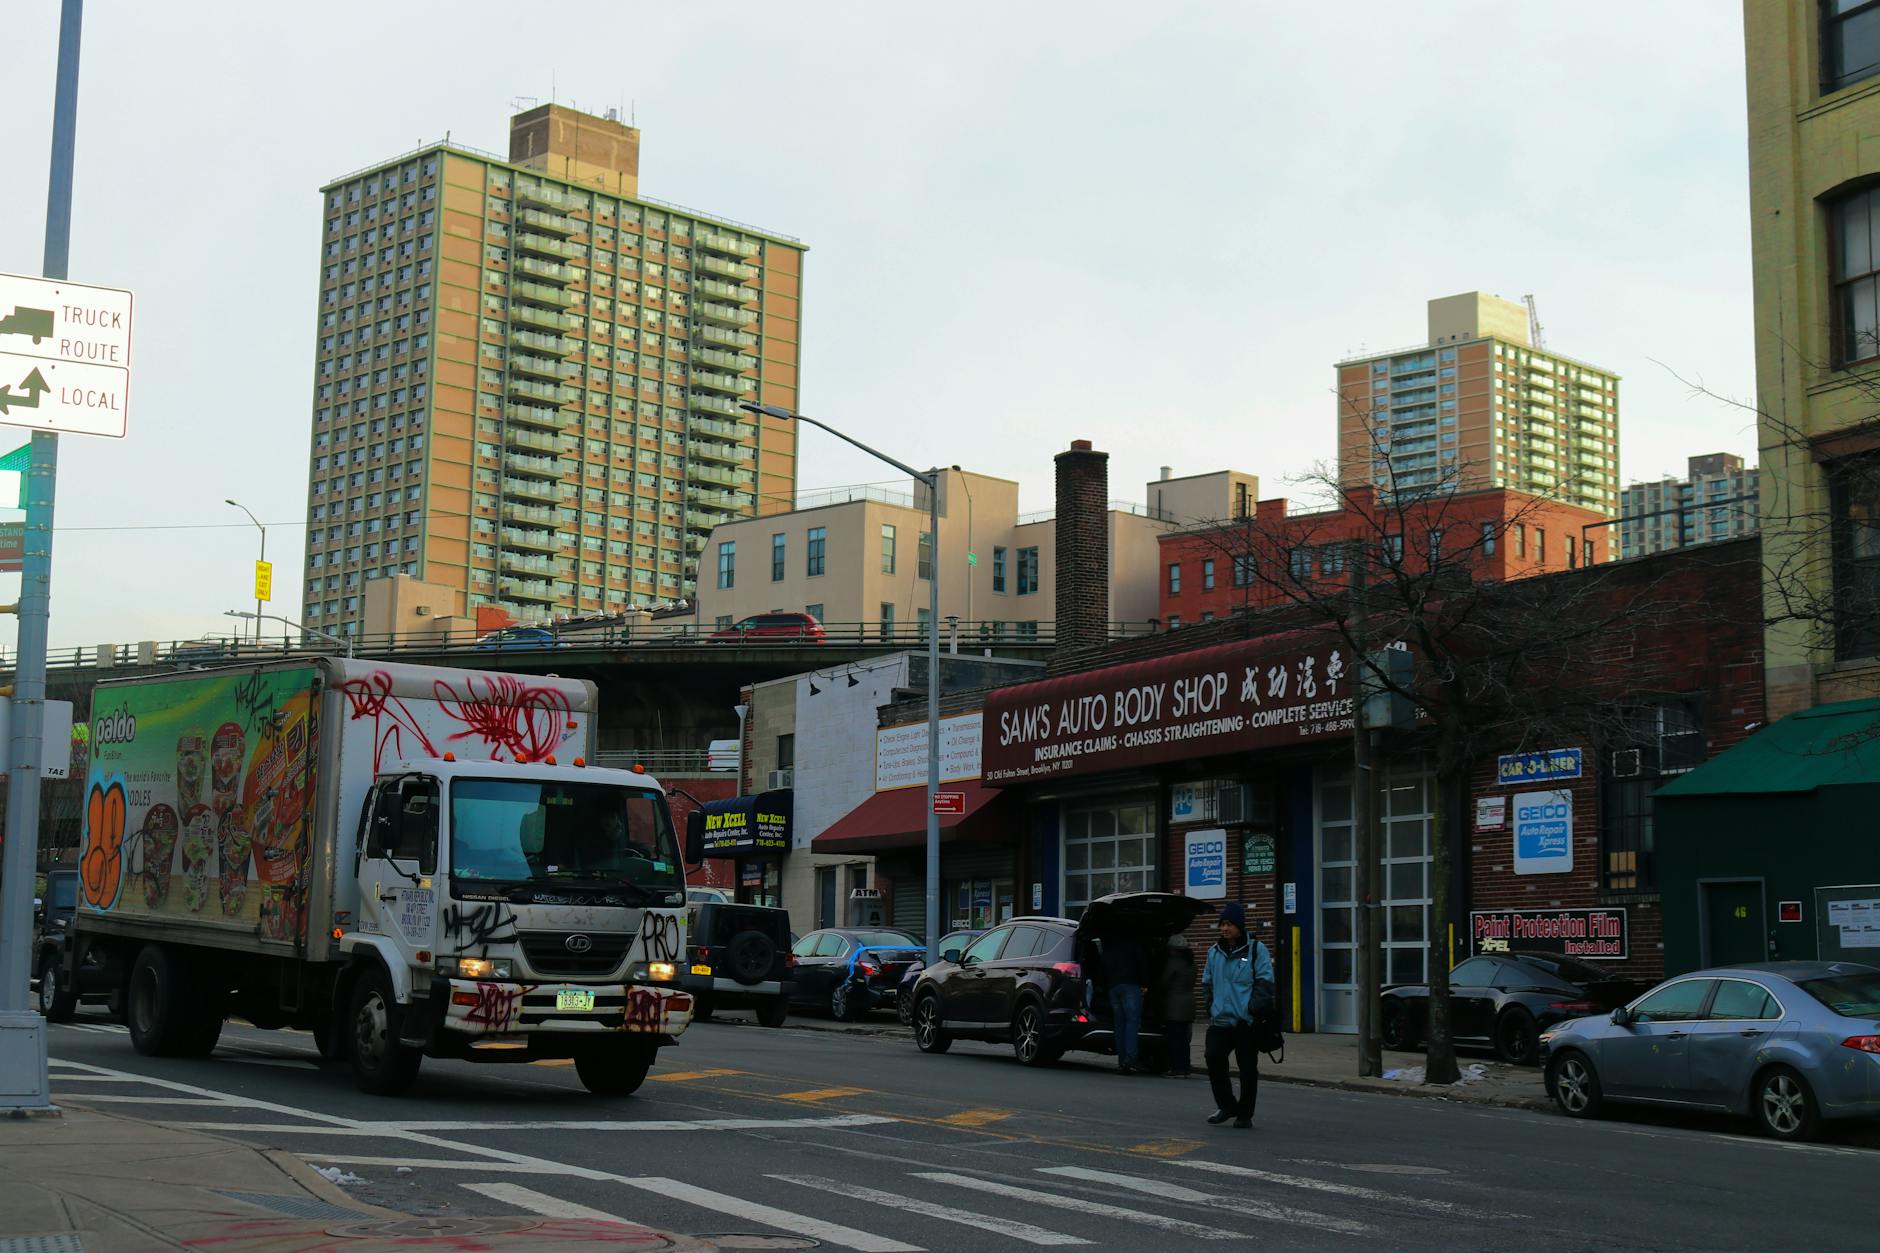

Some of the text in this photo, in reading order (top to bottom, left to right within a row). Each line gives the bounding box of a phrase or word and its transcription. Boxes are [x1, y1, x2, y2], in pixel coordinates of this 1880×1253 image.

[63, 305, 121, 329] TRUCK
[60, 339, 119, 362] ROUTE
[61, 387, 120, 411] LOCAL
[1000, 671, 1229, 747] SAM'S AUTO BODY SHOP
[95, 704, 136, 758] paldo
[1034, 697, 1354, 762] INSURANCE CLAIMS CHASSIS STRAIGHTENING COMPLETE SERVICE
[986, 771, 993, 781] 50
[994, 770, 1003, 780] Old
[128, 790, 152, 807] ODLES
[1519, 804, 1568, 821] GEICO
[1520, 824, 1566, 836] Auto Repair
[1188, 841, 1223, 855] GEICO
[1538, 837, 1566, 848] Xpress
[462, 893, 487, 901] NISSAN
[855, 889, 878, 897] ATM
[1474, 911, 1622, 939] Paint Protection Film
[641, 910, 679, 961] PRO
[1480, 937, 1511, 952] XPEL
[1563, 940, 1621, 955] Installed
